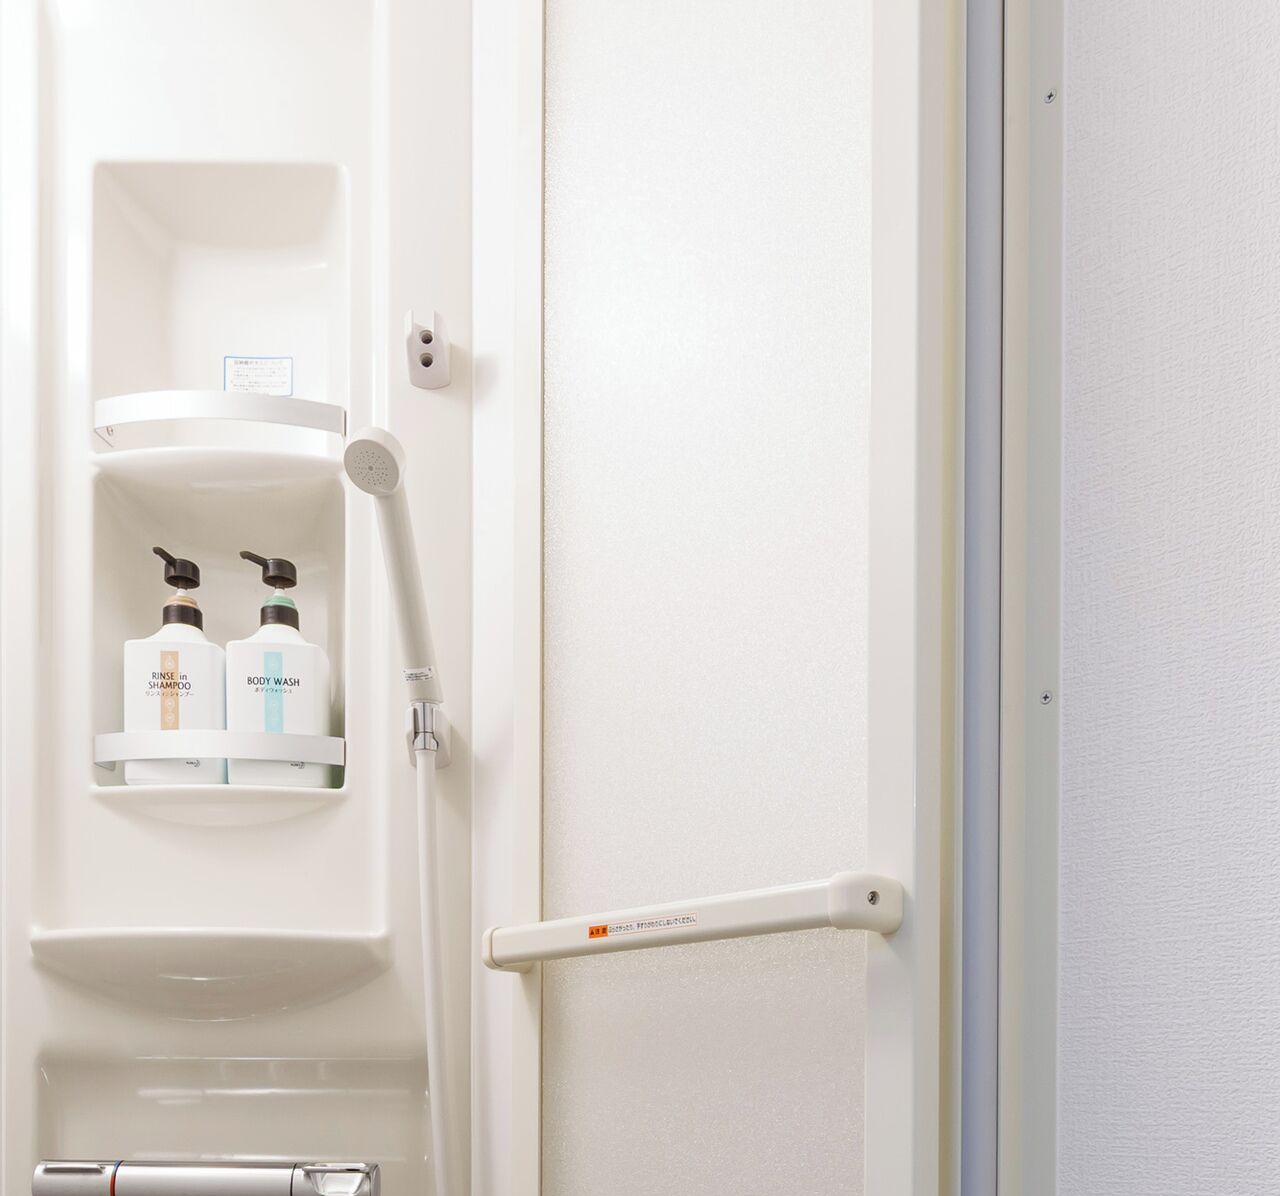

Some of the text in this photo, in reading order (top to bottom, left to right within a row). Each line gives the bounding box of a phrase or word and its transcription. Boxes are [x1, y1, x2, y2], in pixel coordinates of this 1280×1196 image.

[151, 671, 188, 681] RINSE in
[148, 681, 192, 690] SHAMPOO
[247, 676, 300, 687] BODY WASH
